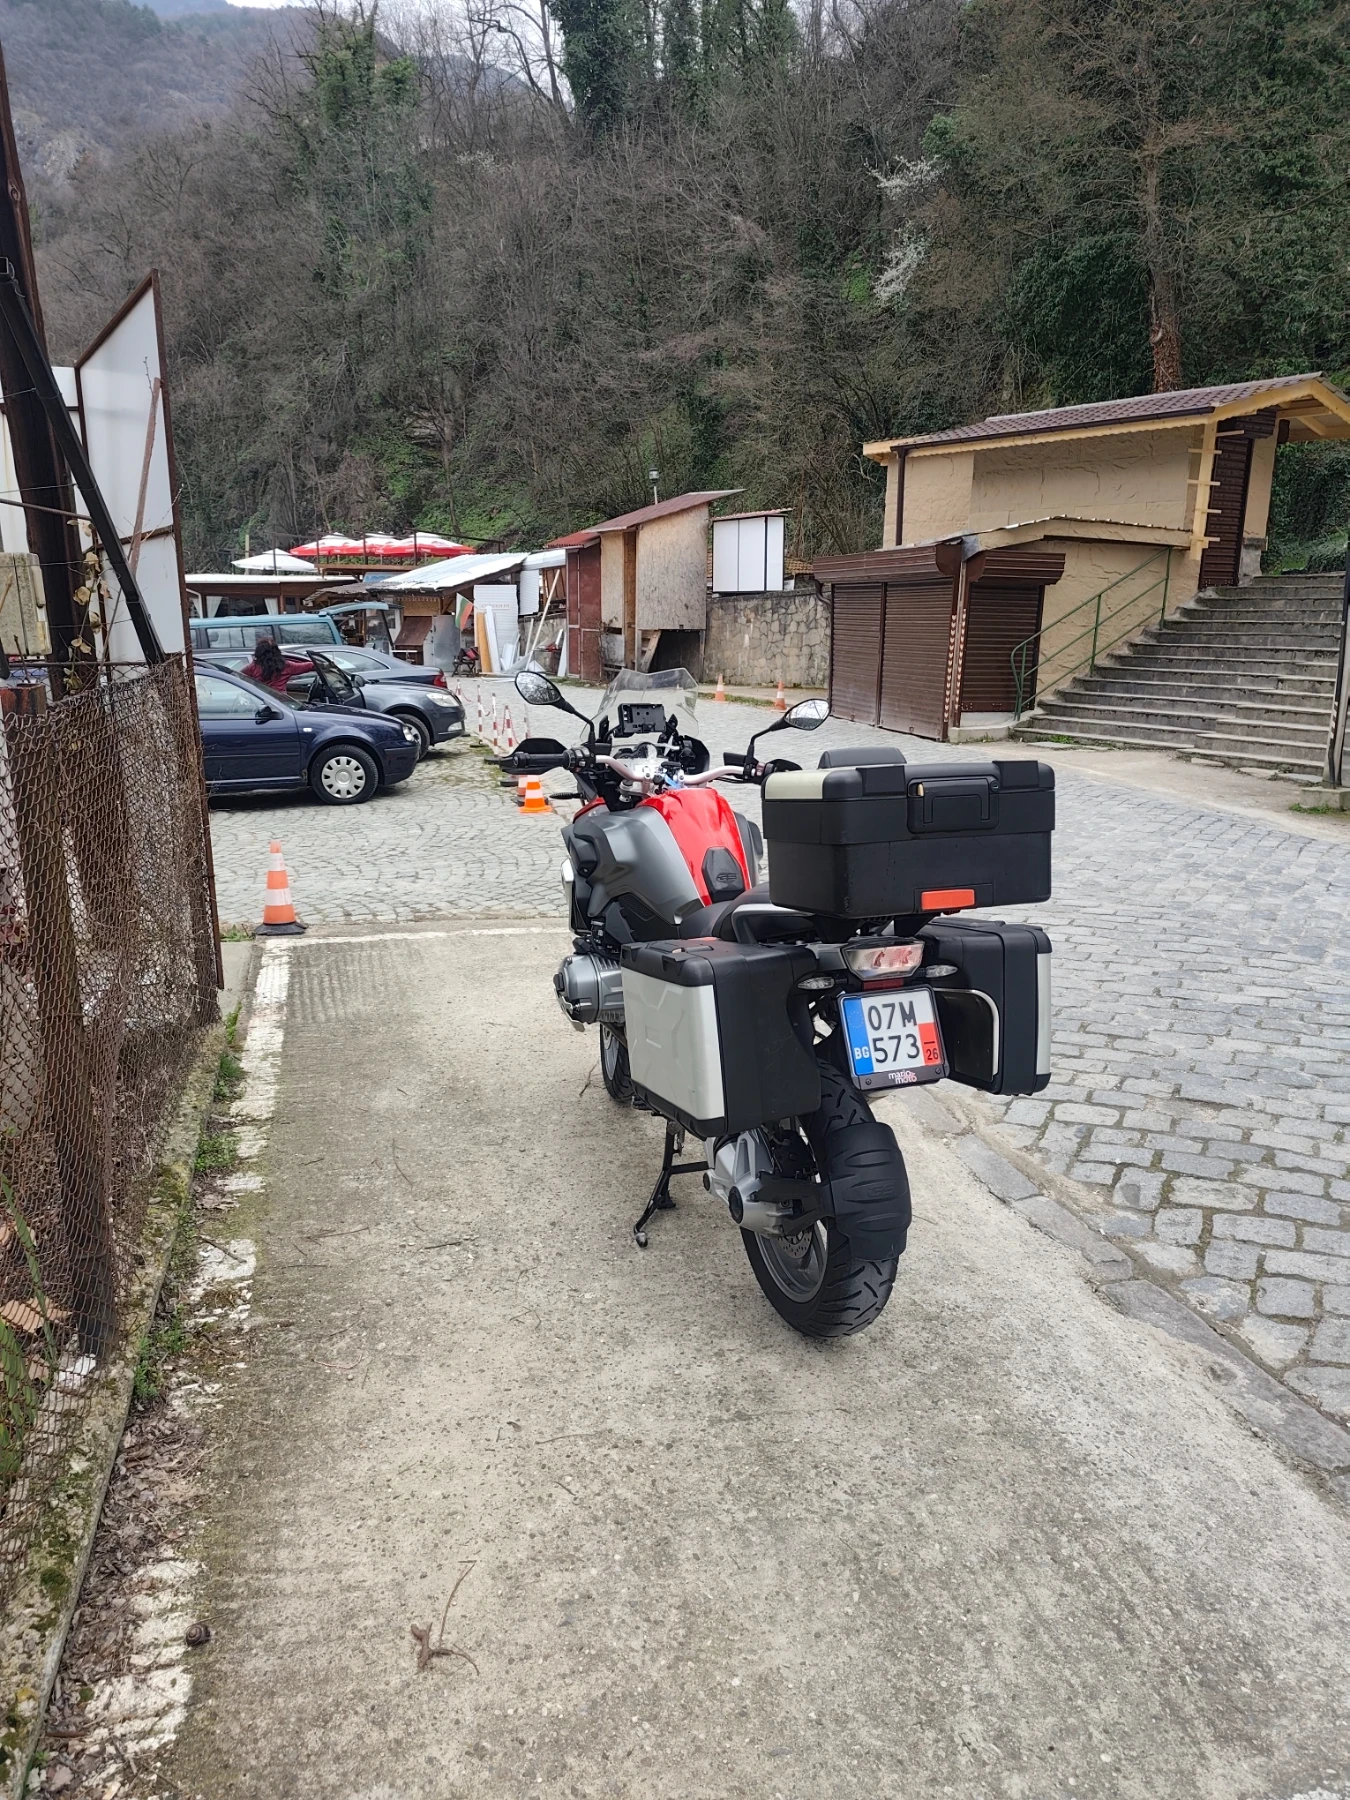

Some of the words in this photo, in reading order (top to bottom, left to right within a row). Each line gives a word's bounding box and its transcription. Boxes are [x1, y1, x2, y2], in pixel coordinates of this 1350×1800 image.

[868, 1000, 918, 1031] 07M
[854, 1046, 870, 1060] BG
[872, 1033, 920, 1064] 573
[925, 1048, 939, 1061] 26
[888, 1069, 911, 1080] mario
[895, 1075, 918, 1085] moto
